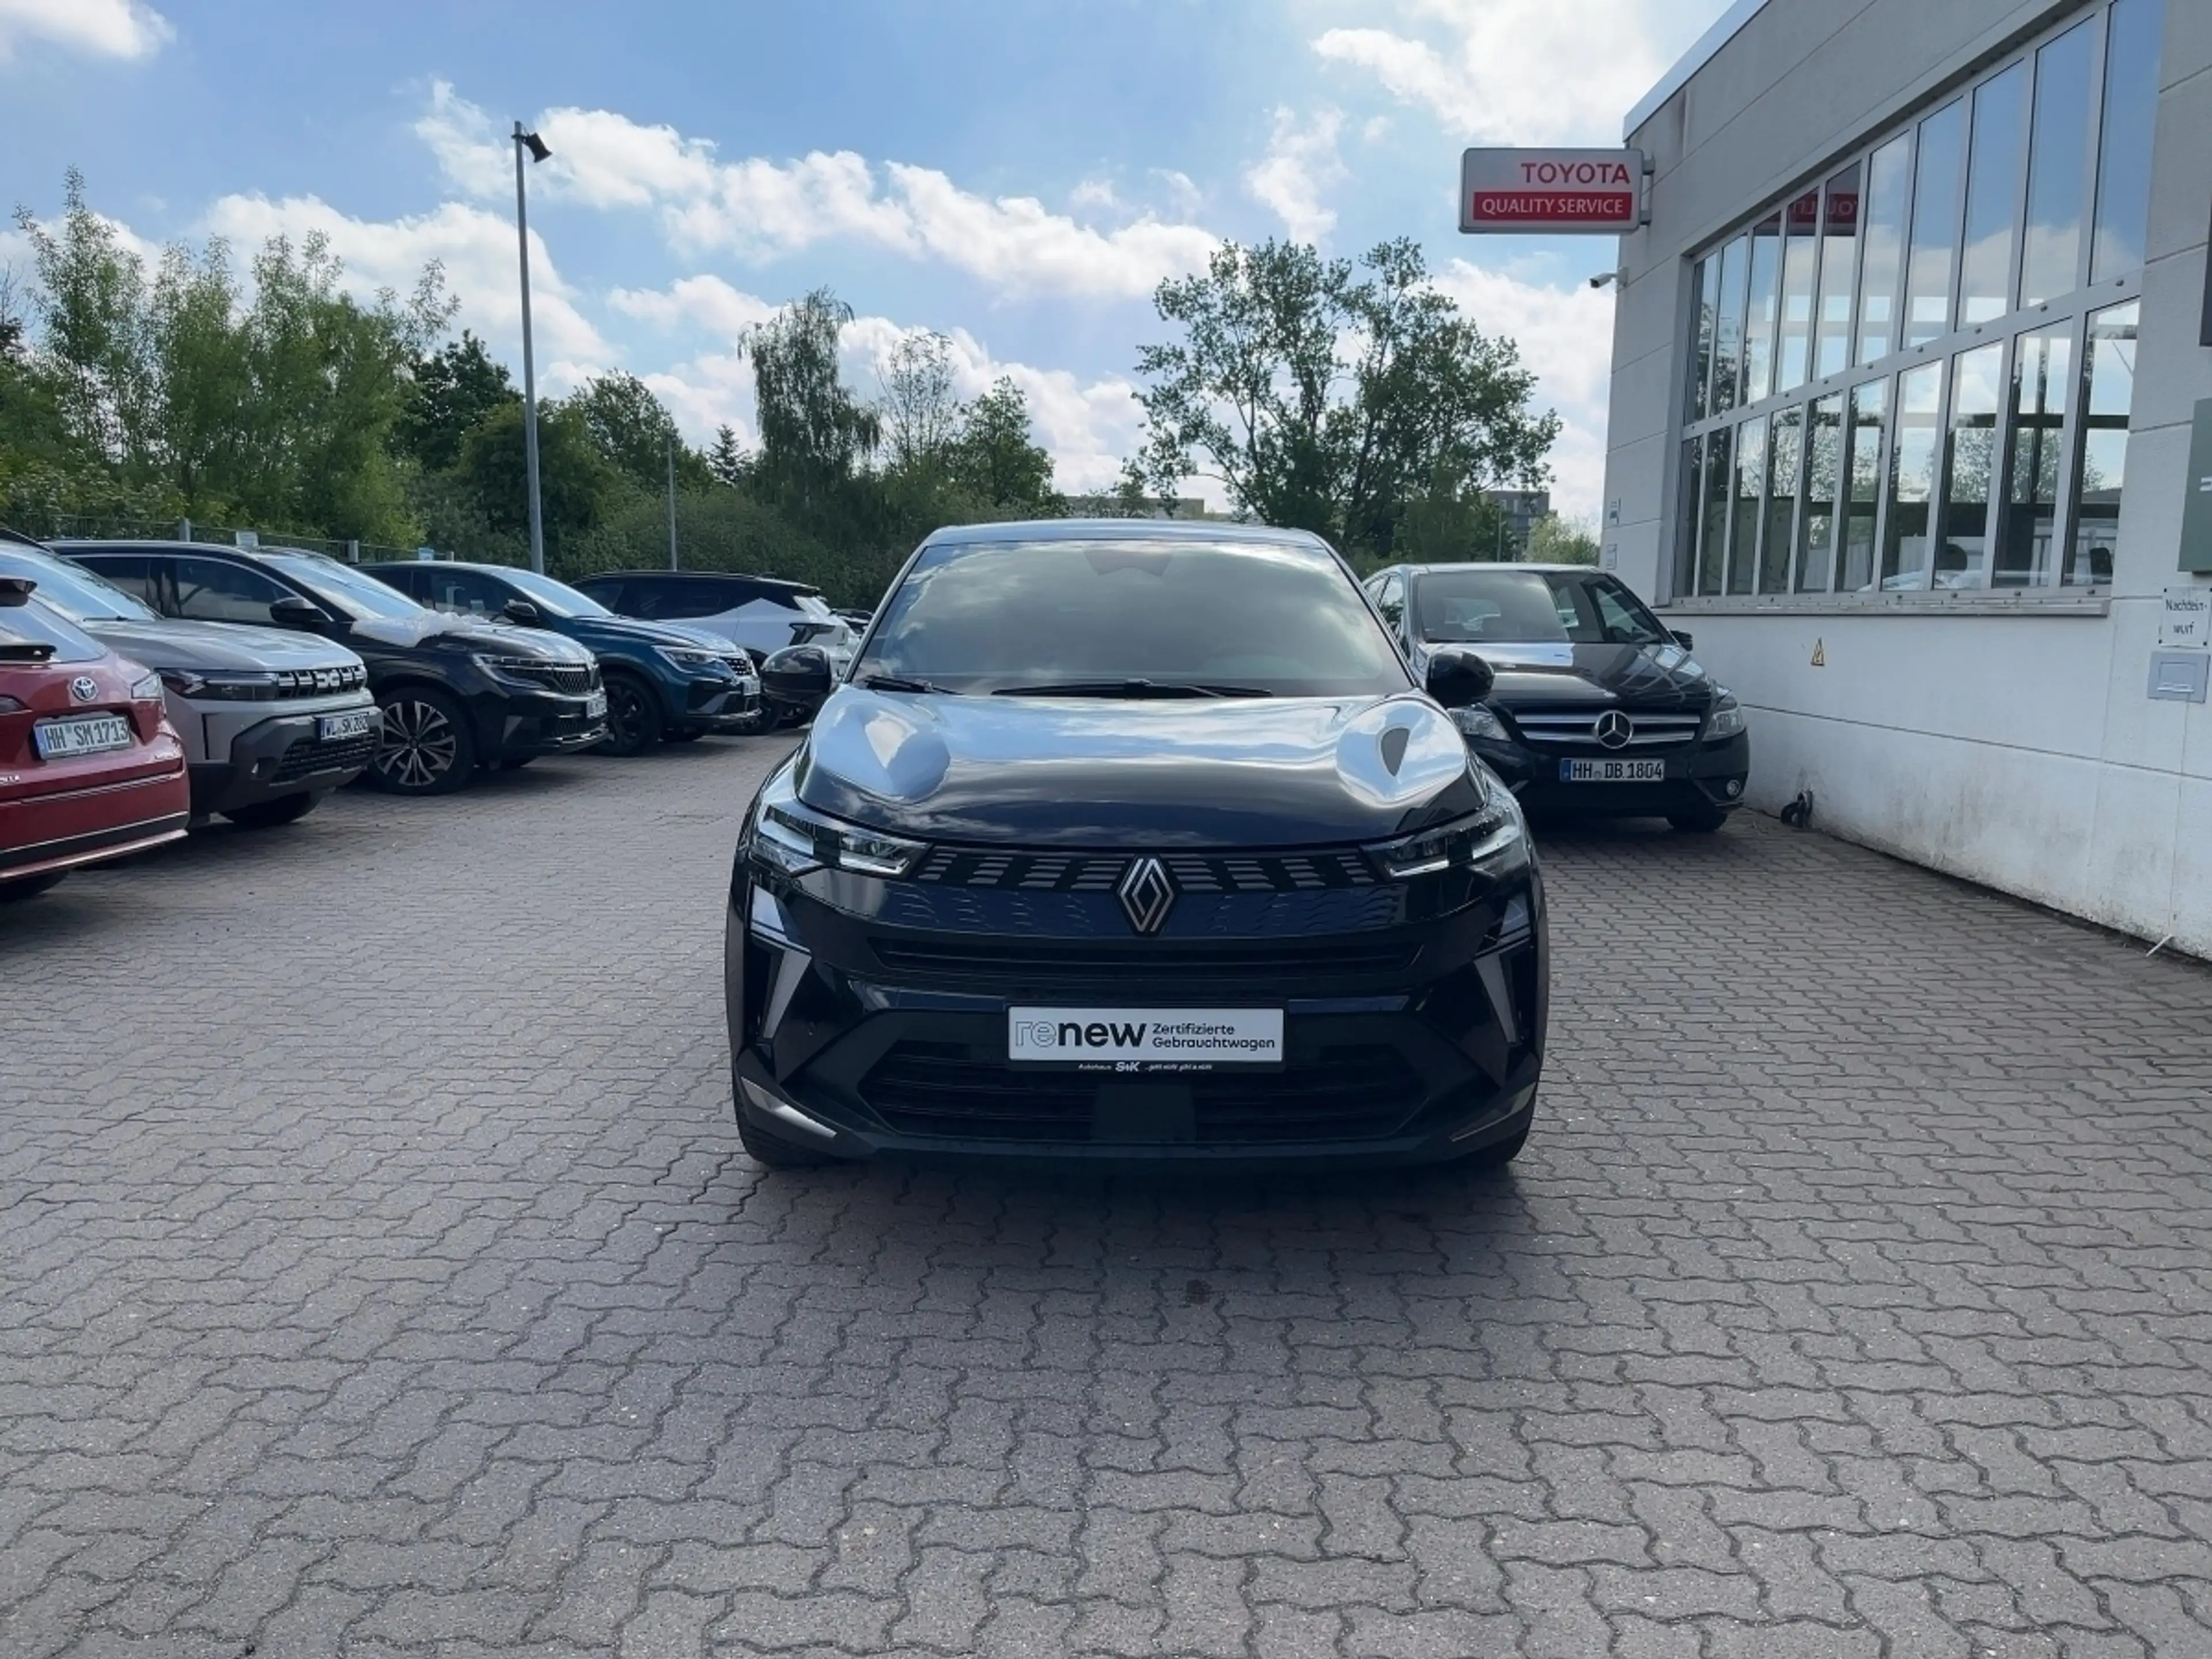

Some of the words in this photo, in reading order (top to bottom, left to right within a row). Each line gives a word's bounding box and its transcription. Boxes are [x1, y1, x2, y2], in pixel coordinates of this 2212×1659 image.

[1521, 162, 1630, 184] TOYOTA
[1482, 199, 1555, 214] QUALITY
[1557, 199, 1623, 213] SERVICE
[44, 726, 67, 750] HH
[1573, 763, 1593, 778] HH
[1016, 1021, 1147, 1047] renew
[1153, 1022, 1235, 1035] Zertifizierte
[1152, 1036, 1275, 1051] Gebrauchtwagen
